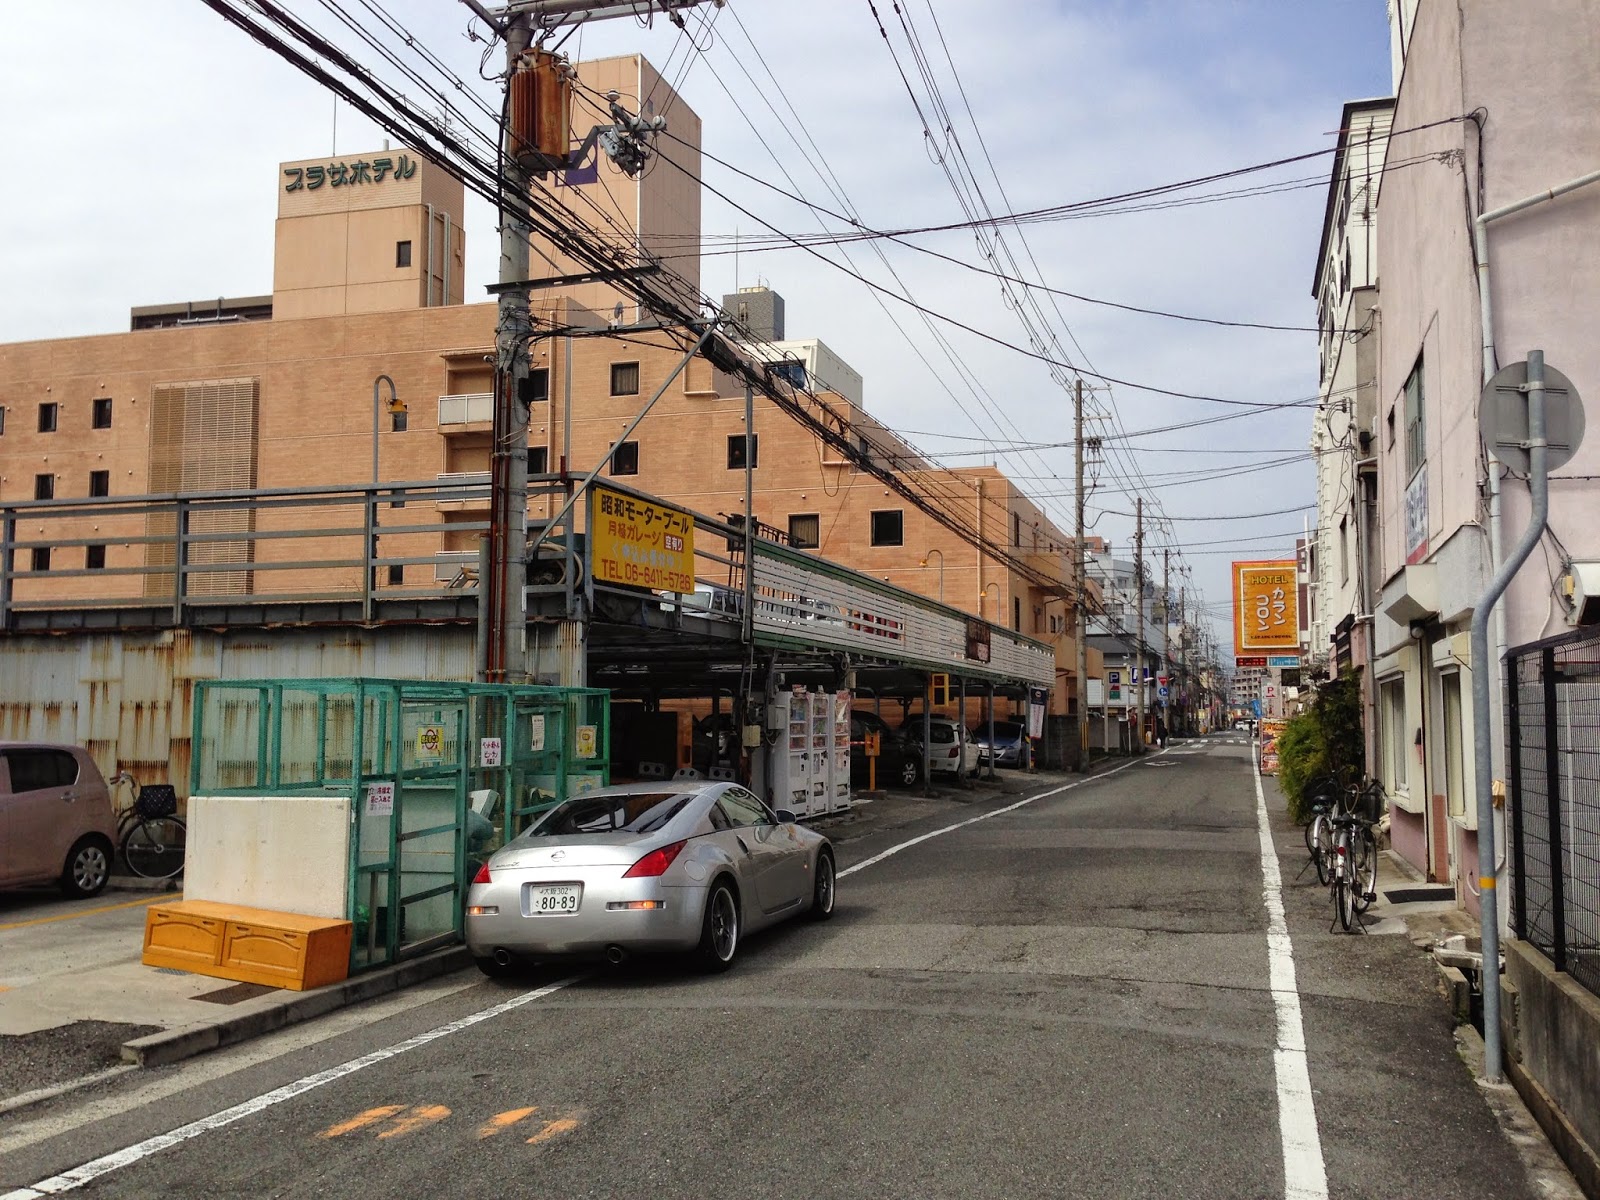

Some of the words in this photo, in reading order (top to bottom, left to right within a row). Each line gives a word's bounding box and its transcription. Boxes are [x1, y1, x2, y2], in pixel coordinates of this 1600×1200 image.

[601, 495, 689, 534] 昭和モータープール
[608, 520, 662, 546] 月極ガレージ
[665, 535, 683, 551] 空有り
[601, 558, 623, 579] TEL
[1251, 575, 1288, 585] HOTEL
[1256, 594, 1271, 632] コロン
[1272, 586, 1286, 625] カラン
[1267, 686, 1274, 694] P
[541, 896, 576, 910] 80-89
